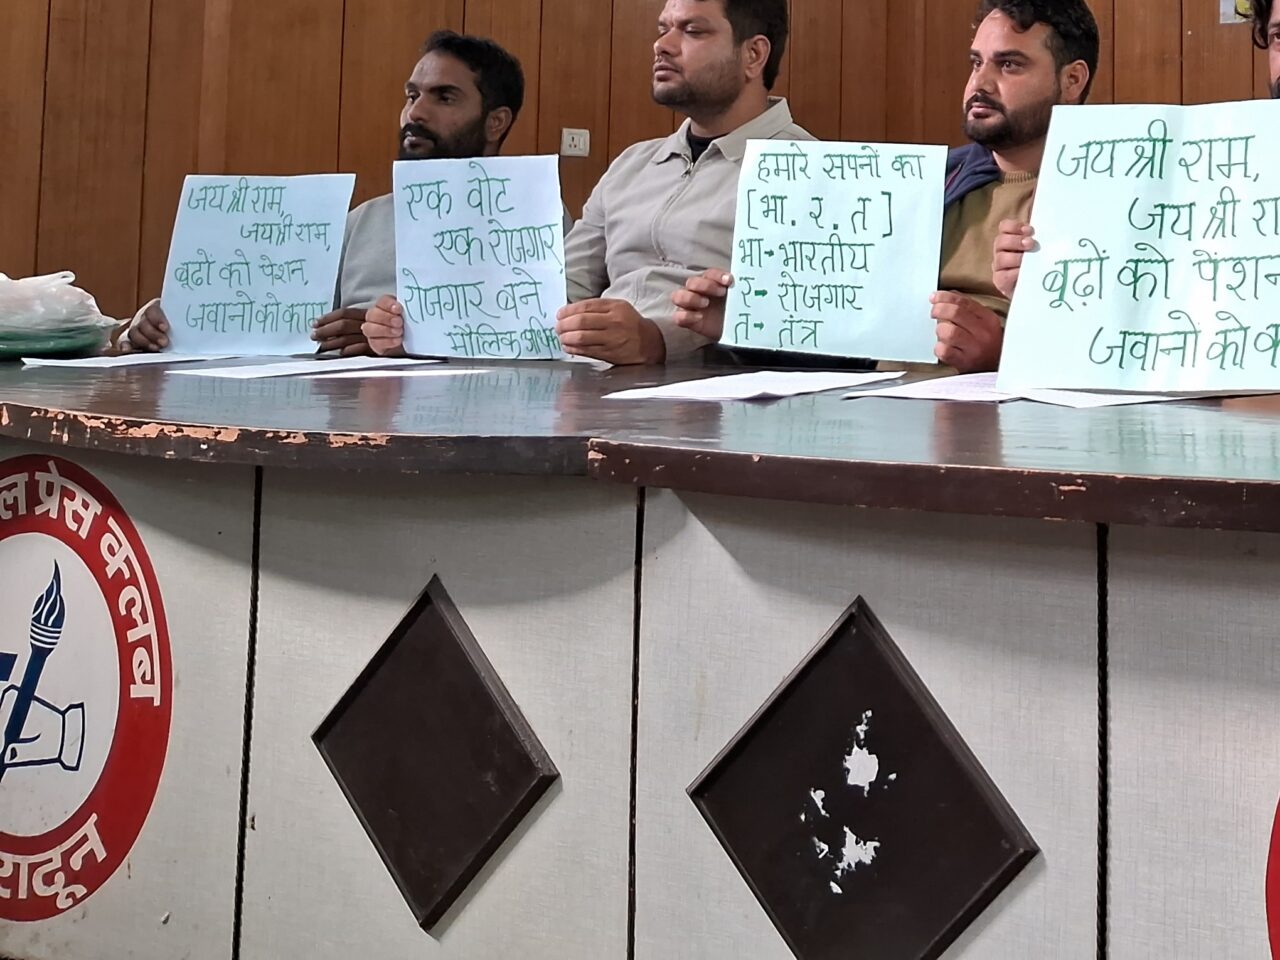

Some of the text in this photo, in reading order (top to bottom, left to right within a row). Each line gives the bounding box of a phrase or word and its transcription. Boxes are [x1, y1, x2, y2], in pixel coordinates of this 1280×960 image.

[758, 142, 927, 183] हमारे सपनों का
[1179, 134, 1260, 183] राम,
[402, 161, 515, 221] एक वोट
[219, 248, 252, 289] को
[433, 226, 485, 266] एक
[777, 270, 865, 313] रोजगार
[1117, 242, 1175, 301] को
[255, 291, 282, 334] को
[402, 267, 501, 324] रोजगार
[444, 322, 522, 360] मौलिक
[1206, 311, 1251, 371] को
[35, 460, 162, 708] प्रेस क्लब
